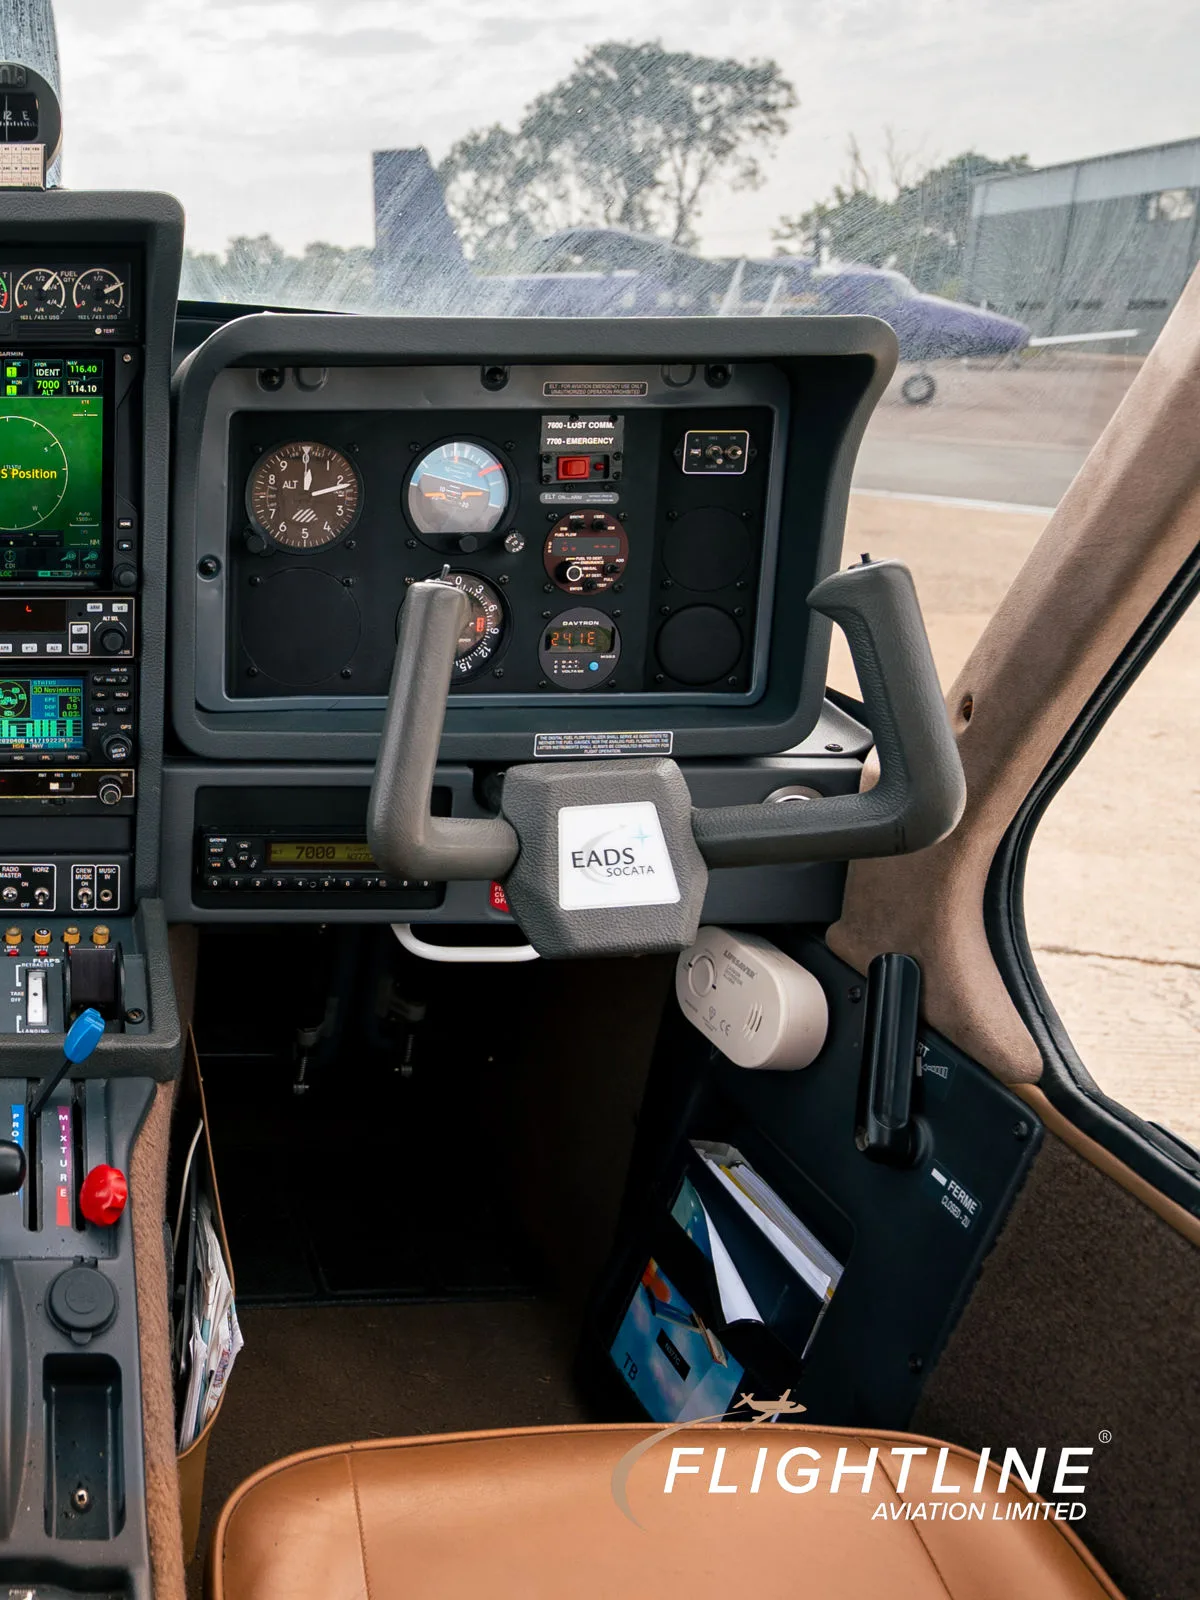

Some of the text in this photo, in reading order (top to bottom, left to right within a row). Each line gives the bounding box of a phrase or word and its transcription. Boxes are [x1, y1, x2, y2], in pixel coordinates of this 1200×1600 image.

[37, 380, 60, 389] 7000
[588, 421, 614, 429] COMM.
[280, 460, 288, 471] 9
[12, 469, 56, 479] Position
[269, 474, 276, 485] 8
[282, 480, 298, 489] ALT
[269, 509, 276, 519] 7
[336, 505, 344, 516] 3
[279, 521, 287, 532] 6
[323, 521, 331, 531] 4
[302, 528, 309, 539] 5
[456, 576, 462, 585] 0
[476, 585, 484, 594] 3
[488, 604, 497, 612] 6
[478, 646, 491, 658] 12
[460, 662, 472, 672] 15
[296, 846, 335, 859] 7000
[571, 848, 635, 868] EADS
[606, 866, 655, 878] SOCATA
[58, 1114, 68, 1197] MIXTURE
[947, 1180, 979, 1215] FERME
[624, 1351, 638, 1380] TB
